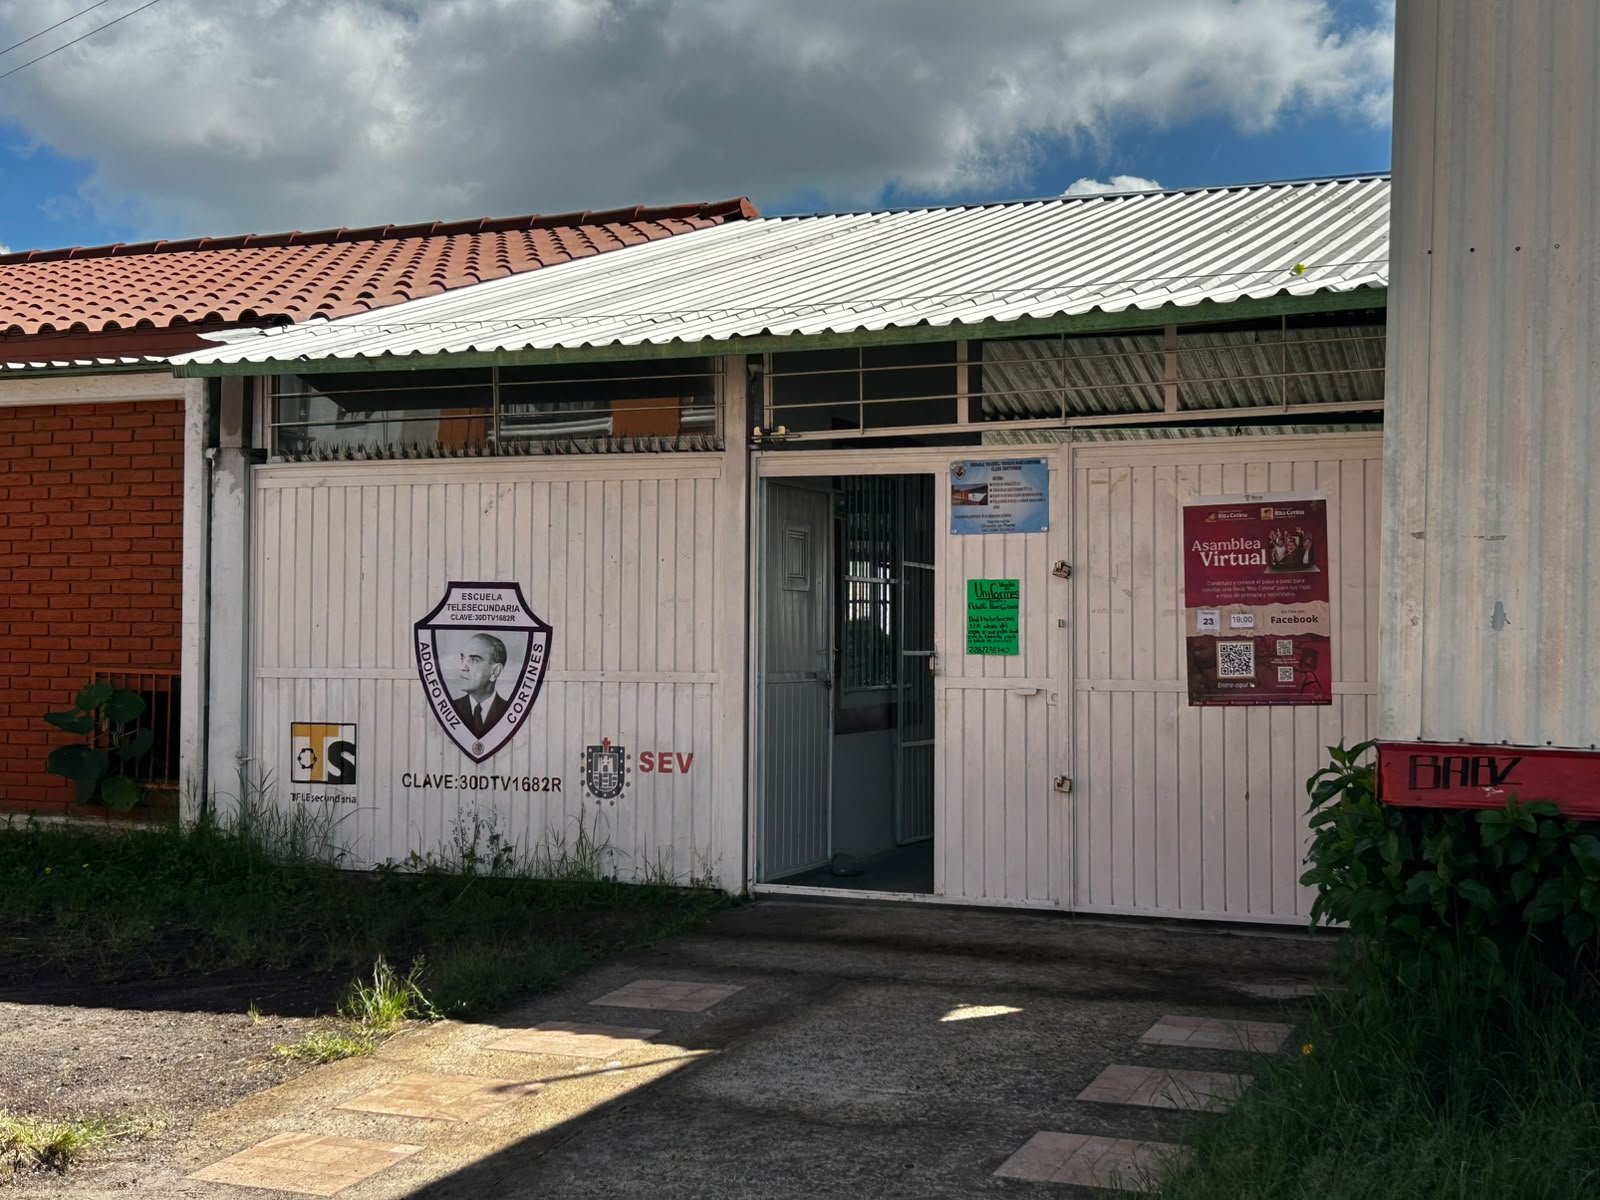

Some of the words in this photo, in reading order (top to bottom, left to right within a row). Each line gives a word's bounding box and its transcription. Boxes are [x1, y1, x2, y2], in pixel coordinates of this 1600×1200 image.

[1191, 537, 1261, 552] Asamblea
[1200, 548, 1268, 567] Virtual
[461, 592, 503, 601] ESCUELA
[446, 603, 521, 613] TELESECUNDARIA
[450, 613, 516, 622] CLAVE:30DTV1682R
[1203, 617, 1215, 626] 23
[1270, 614, 1319, 624] Facebook
[420, 642, 442, 698] ADOLFO
[437, 699, 461, 730] RIUZ
[507, 643, 543, 724] CORTINES
[638, 751, 695, 773] SEV
[401, 772, 562, 793] CLAVE:30DTV1682R
